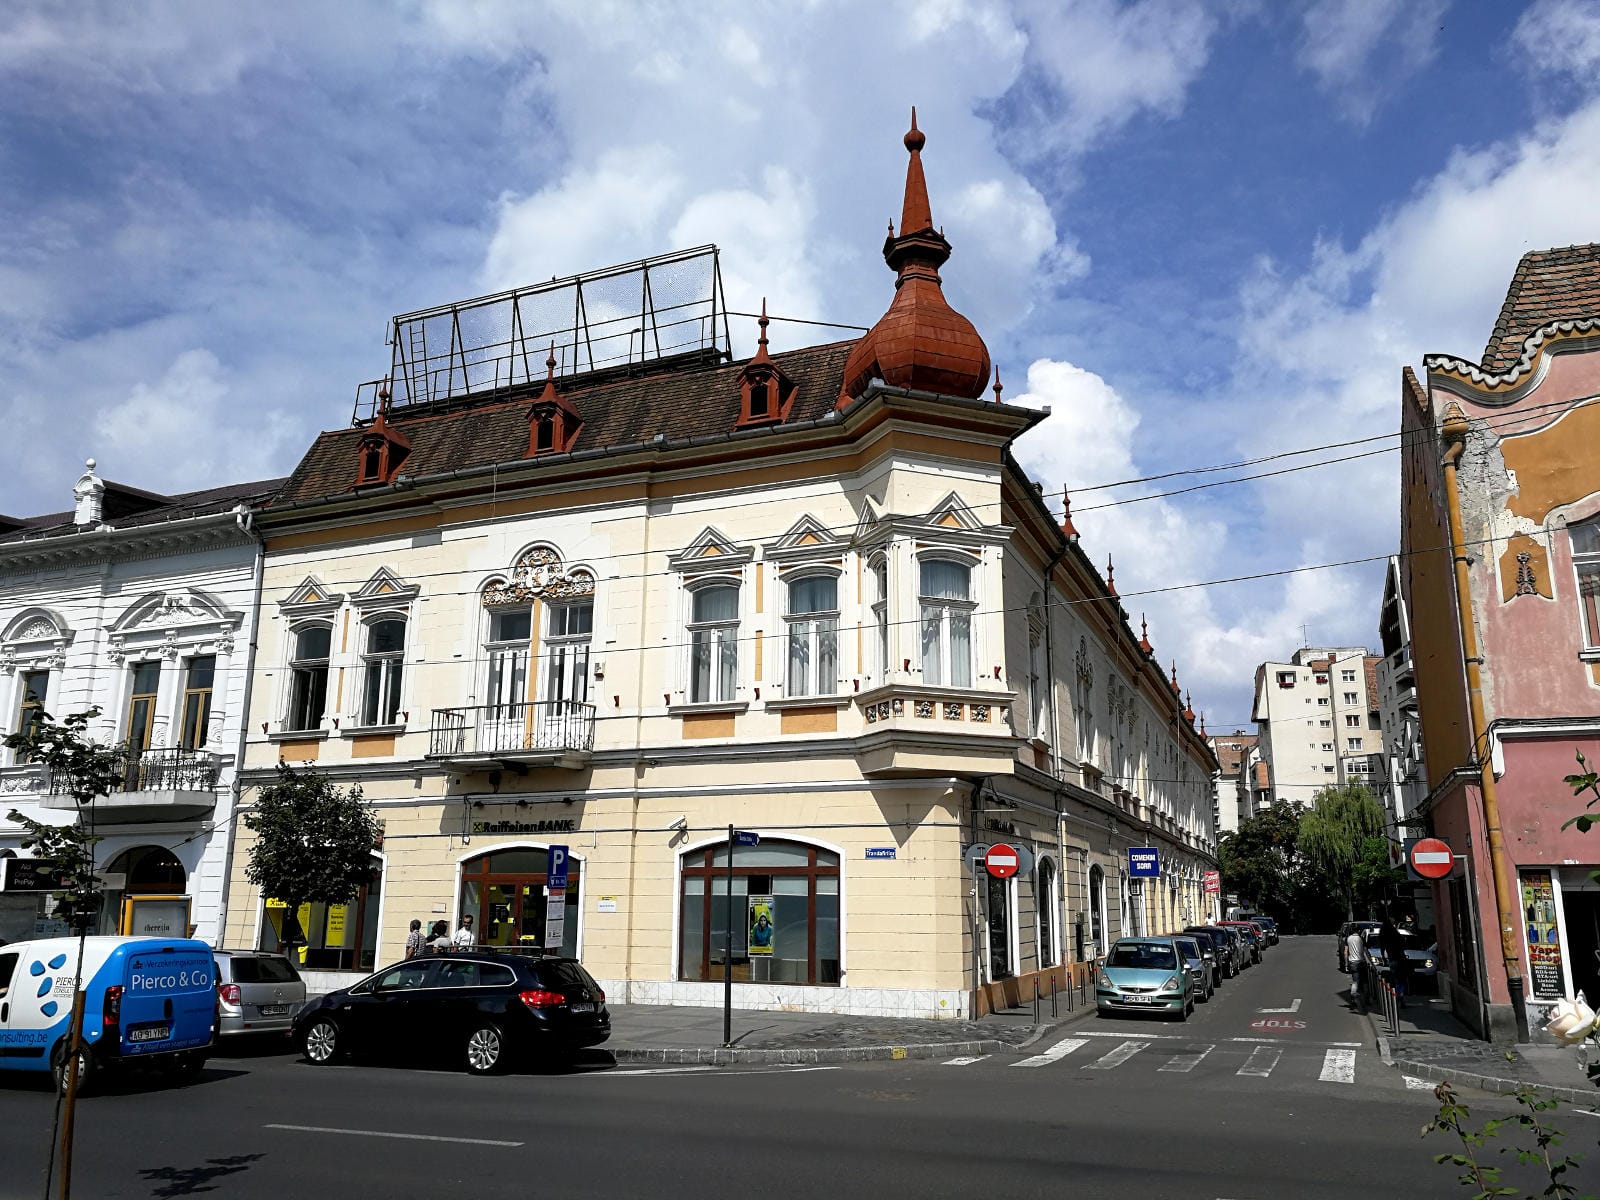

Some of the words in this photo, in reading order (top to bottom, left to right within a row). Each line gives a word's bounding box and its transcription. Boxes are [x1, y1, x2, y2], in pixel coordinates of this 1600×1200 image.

[552, 849, 564, 875] P
[1529, 944, 1559, 955] Vape
[1530, 953, 1560, 963] Shop
[132, 974, 176, 990] Pierco
[179, 971, 189, 987] &
[191, 970, 208, 986] Co
